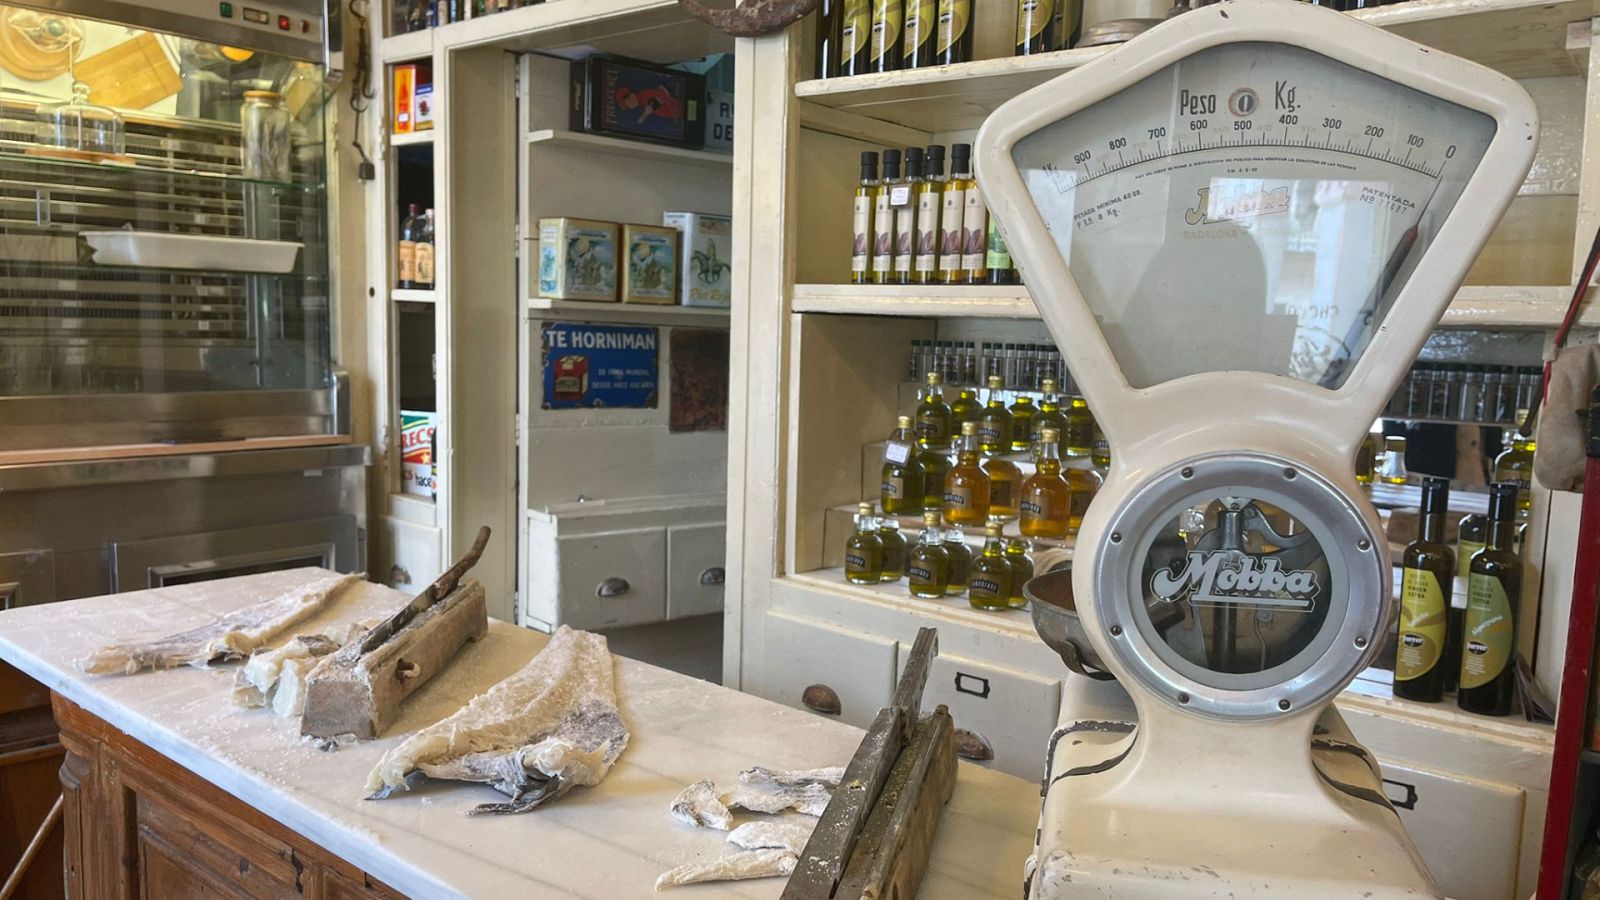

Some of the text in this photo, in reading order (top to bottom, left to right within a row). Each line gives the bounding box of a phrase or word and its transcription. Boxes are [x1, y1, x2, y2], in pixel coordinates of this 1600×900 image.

[1180, 80, 1301, 116] Peso Kg.
[1073, 150, 1091, 164] 900
[1109, 137, 1127, 150] 800
[1148, 126, 1166, 140] 700
[1190, 119, 1208, 131] 600
[1233, 120, 1252, 131] 500
[1278, 114, 1298, 125] 400
[1322, 117, 1342, 130] 300
[1364, 125, 1384, 138] 200
[1407, 133, 1425, 148] 100
[1444, 145, 1456, 159] 0
[1074, 207, 1096, 220] PESADA
[1097, 196, 1122, 210] MINIMA
[1362, 186, 1416, 209] PATENTADA
[546, 330, 656, 350] TE HORNIMAN
[1152, 551, 1318, 602] Mobba
